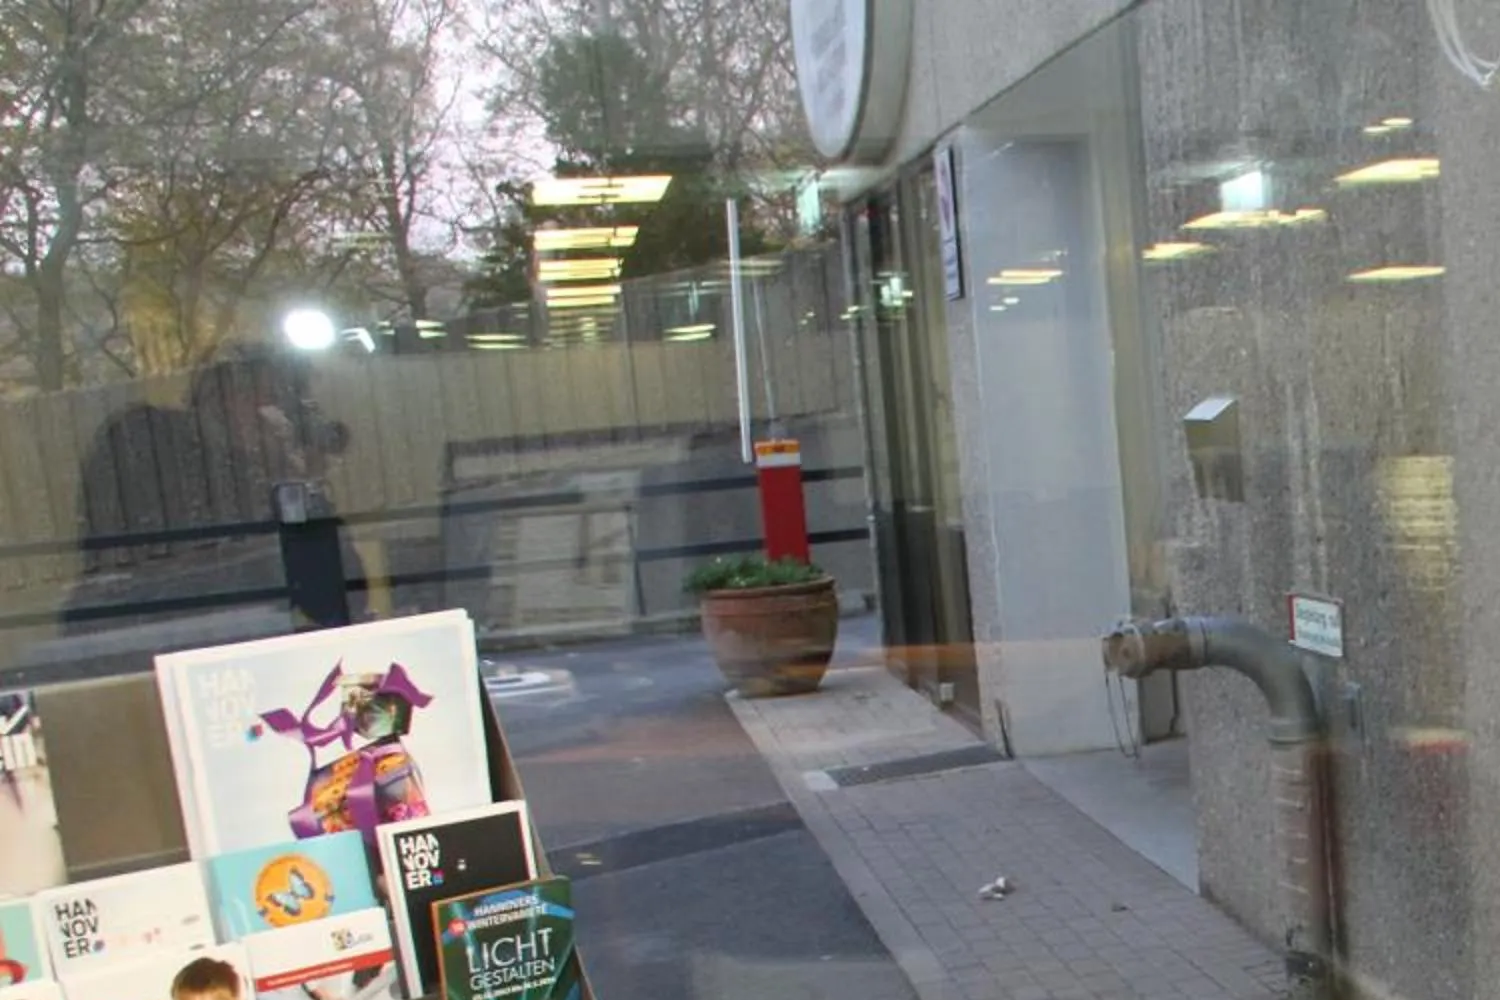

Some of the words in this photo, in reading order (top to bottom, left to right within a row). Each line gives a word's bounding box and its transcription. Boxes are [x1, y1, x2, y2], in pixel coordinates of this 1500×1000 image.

[405, 868, 433, 889] ER
[64, 938, 91, 959] ER
[465, 926, 554, 974] LICHT
[469, 956, 556, 991] GESTALTEN
